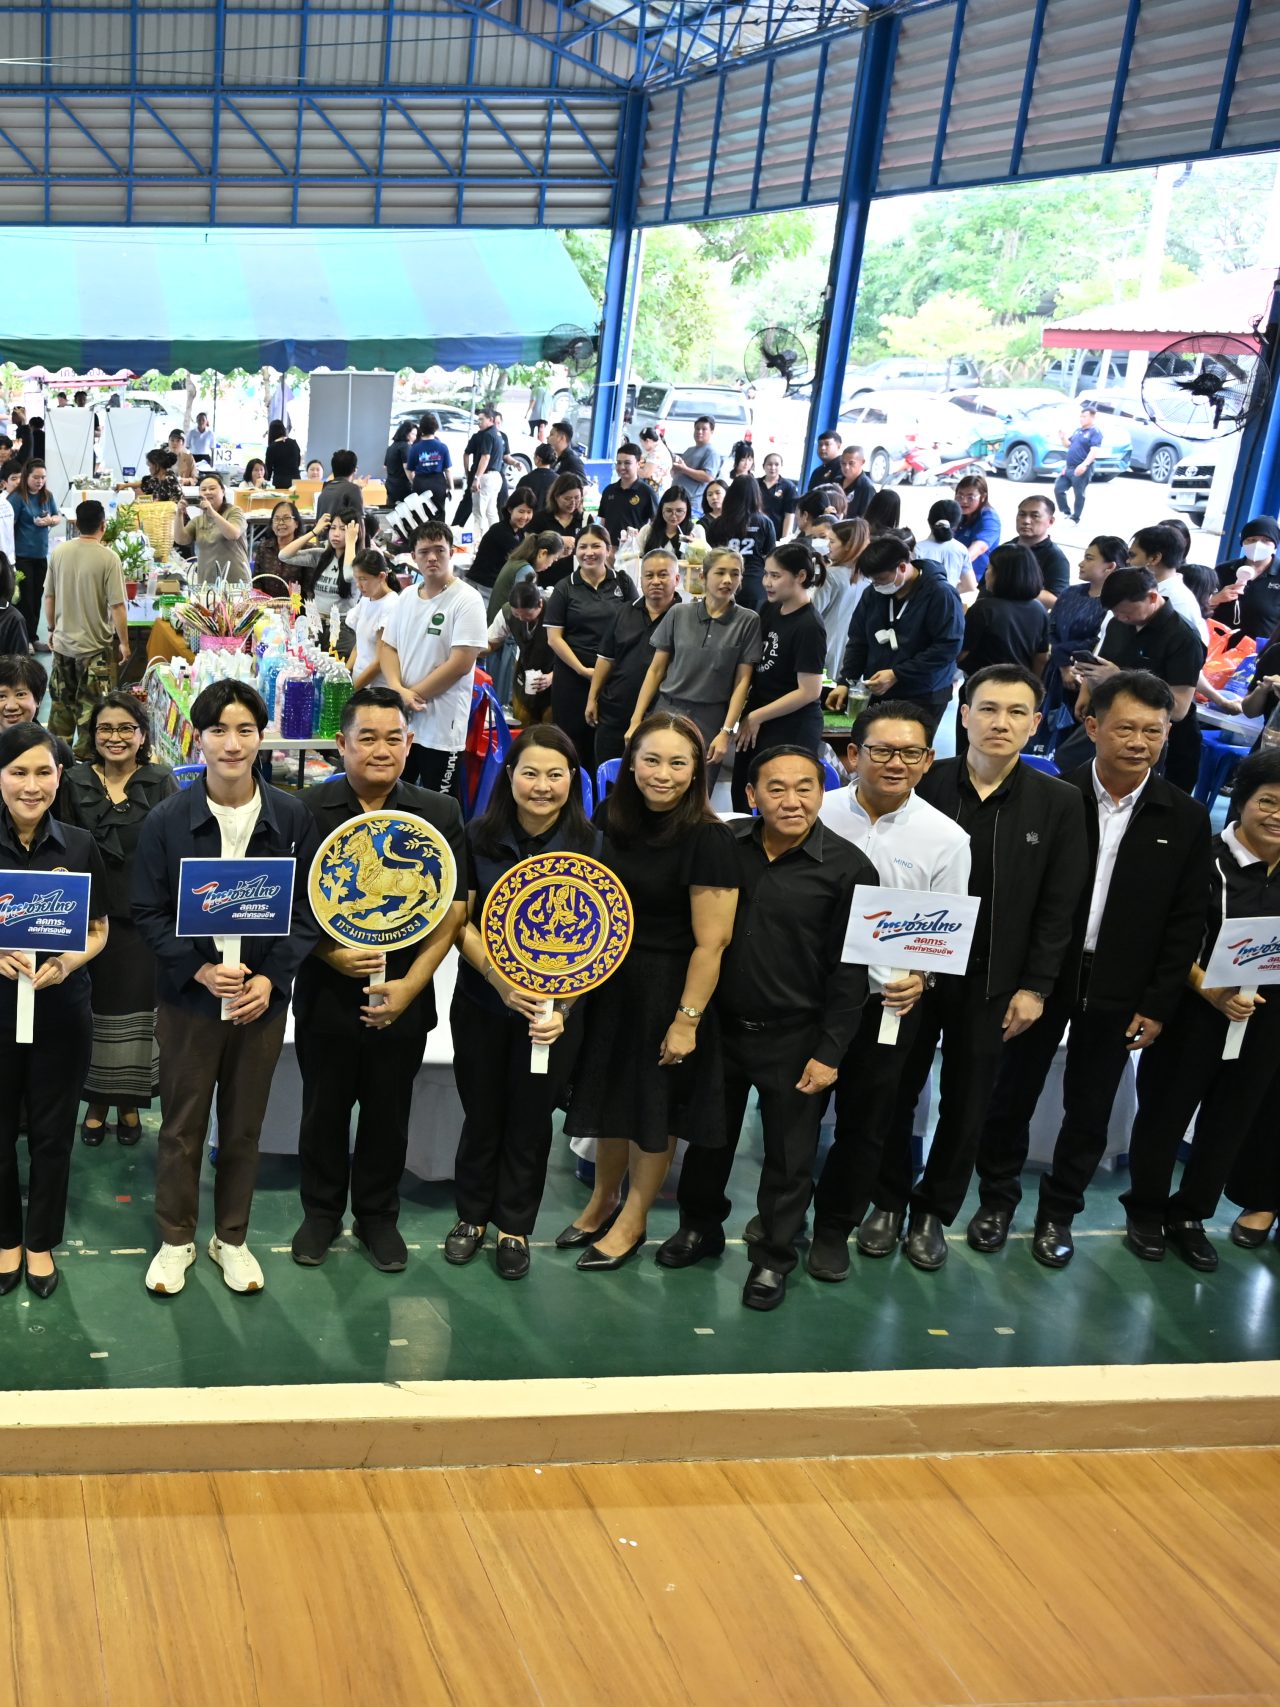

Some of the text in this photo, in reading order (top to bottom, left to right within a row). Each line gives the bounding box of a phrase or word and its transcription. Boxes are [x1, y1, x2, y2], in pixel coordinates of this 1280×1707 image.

[893, 857, 914, 869] MIND
[191, 874, 282, 914] ไทยช่วยไทย
[239, 903, 269, 911] ลดภาระ
[35, 918, 65, 926] ลดภาระ
[863, 909, 962, 942] ไทยช่วยไทย
[336, 919, 422, 942] กรมการปกครอง
[913, 937, 948, 946] ลดภาระ
